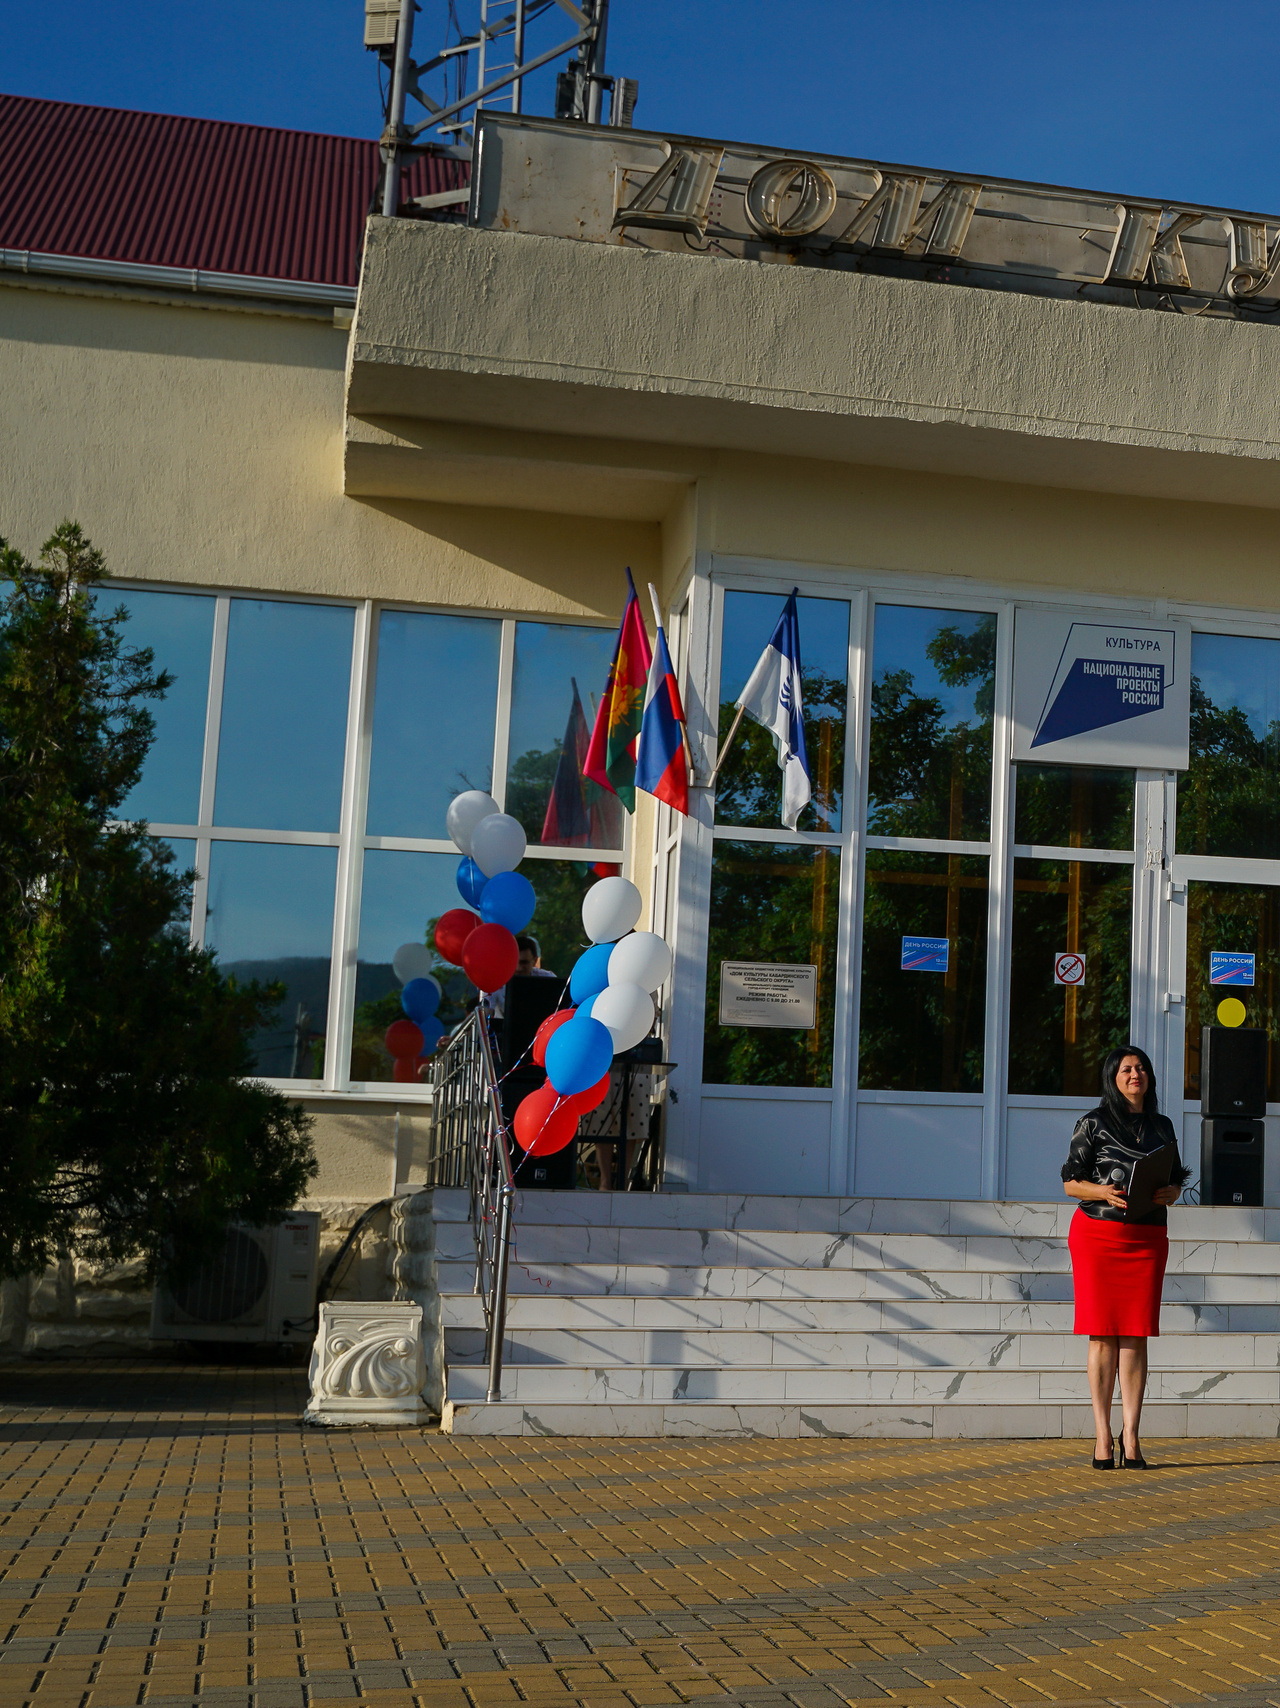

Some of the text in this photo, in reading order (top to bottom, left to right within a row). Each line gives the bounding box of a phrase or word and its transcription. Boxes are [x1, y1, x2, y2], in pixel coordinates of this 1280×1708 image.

[611, 139, 983, 262] ДОМ
[1105, 637, 1161, 651] КУЛЬТУРА
[1083, 662, 1161, 679] НАЦИОНАЛЬНЫЕ
[1116, 678, 1160, 692] ПРОЕКТЫ
[1122, 692, 1160, 706] РОССИИ
